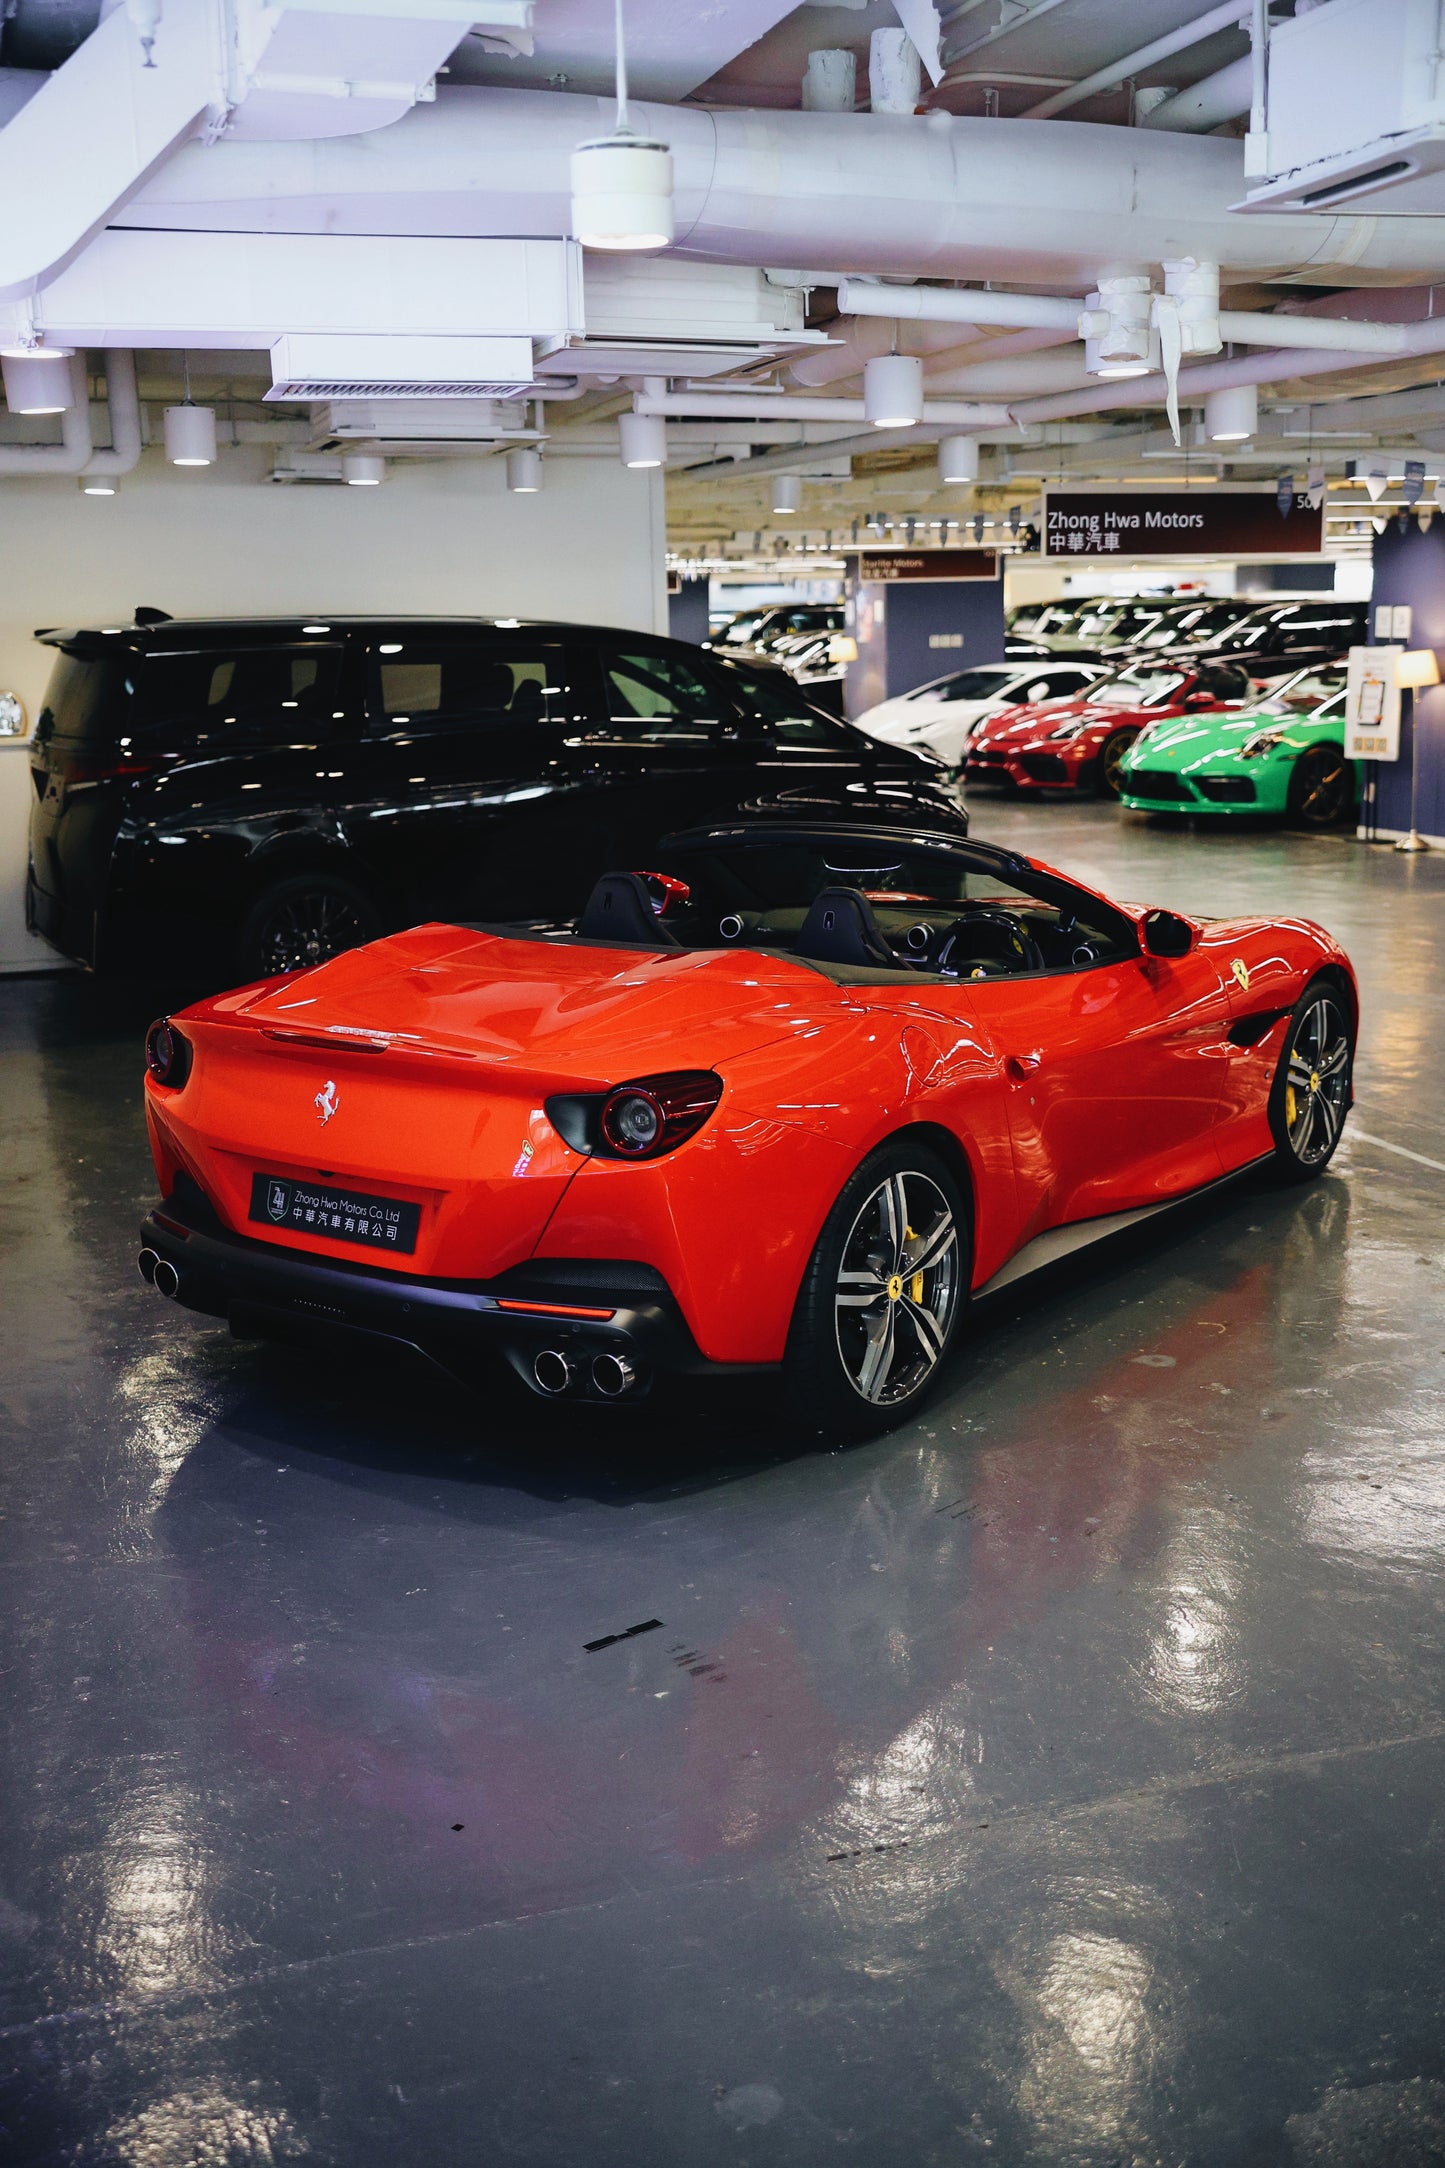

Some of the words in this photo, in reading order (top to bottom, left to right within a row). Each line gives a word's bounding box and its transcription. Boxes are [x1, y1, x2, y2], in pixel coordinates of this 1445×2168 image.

[1048, 512, 1099, 532] Zhong
[1104, 512, 1140, 528] Hwa
[1145, 511, 1204, 528] Motors
[1050, 532, 1120, 551] 中華汽車
[294, 1190, 320, 1208] Zhong
[321, 1199, 338, 1210] Hwa
[339, 1199, 367, 1216] Motors
[369, 1205, 383, 1219] Co.
[385, 1208, 400, 1222] Ltd
[293, 1207, 398, 1241] 中華汽車有限公司
